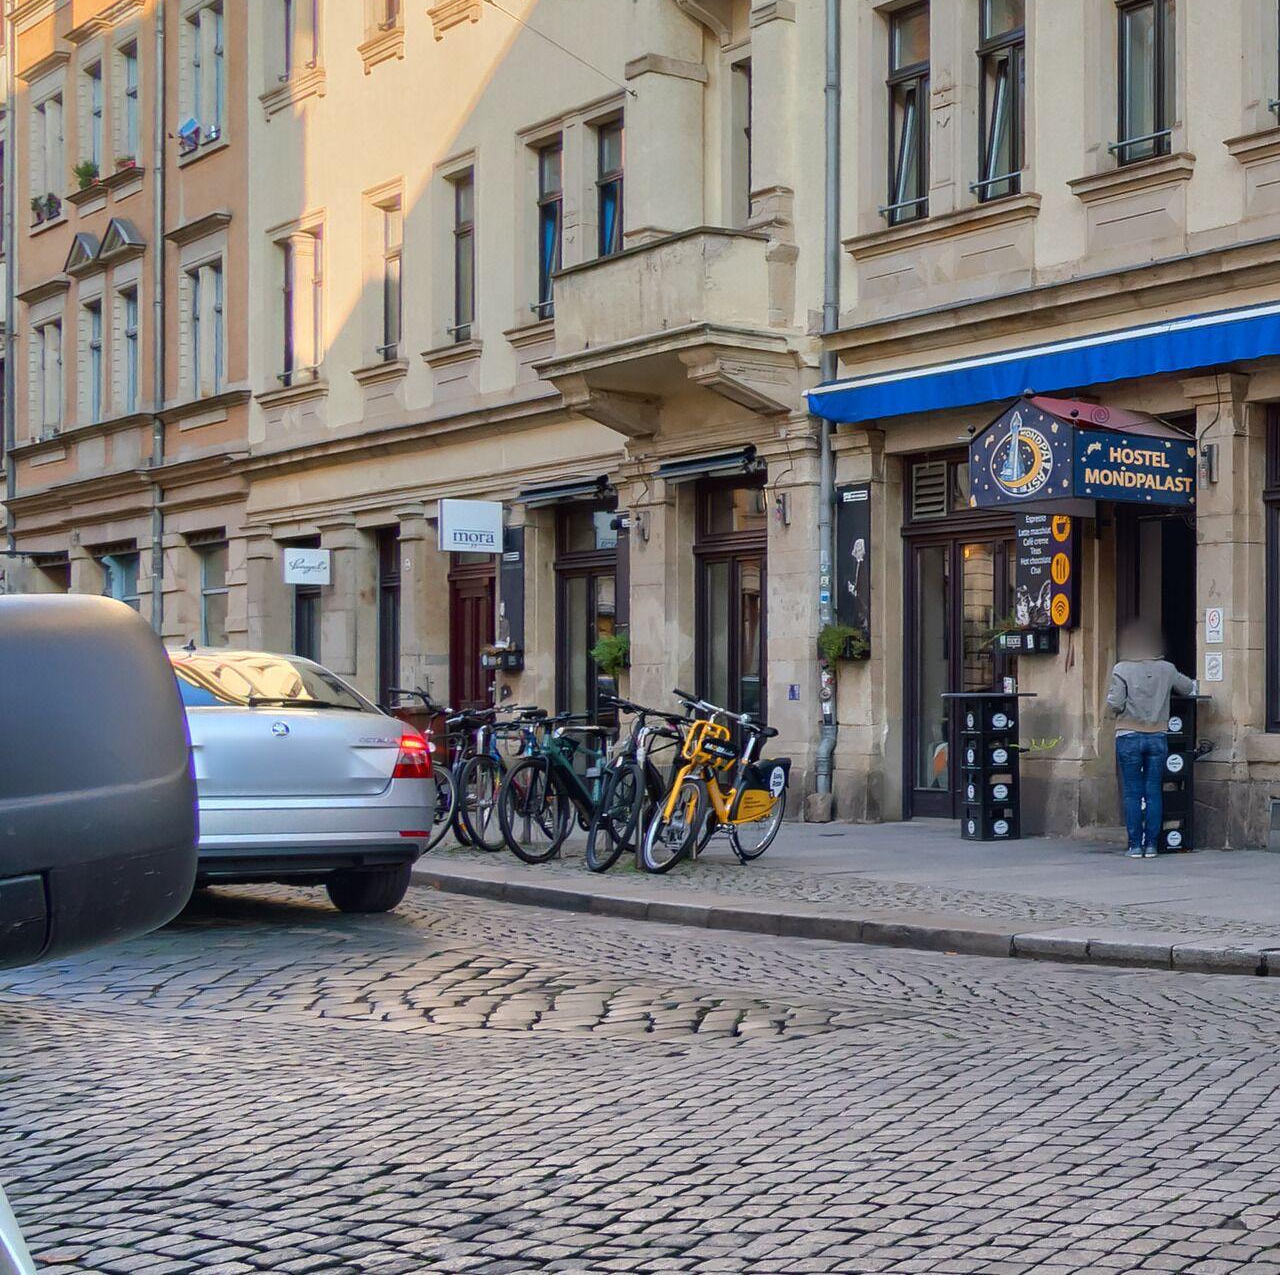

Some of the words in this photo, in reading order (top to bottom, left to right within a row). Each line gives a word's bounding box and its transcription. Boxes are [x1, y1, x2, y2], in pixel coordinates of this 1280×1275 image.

[1109, 446, 1170, 468] HOSTEL
[1085, 468, 1194, 493] MONDPALAST
[453, 532, 495, 543] mora
